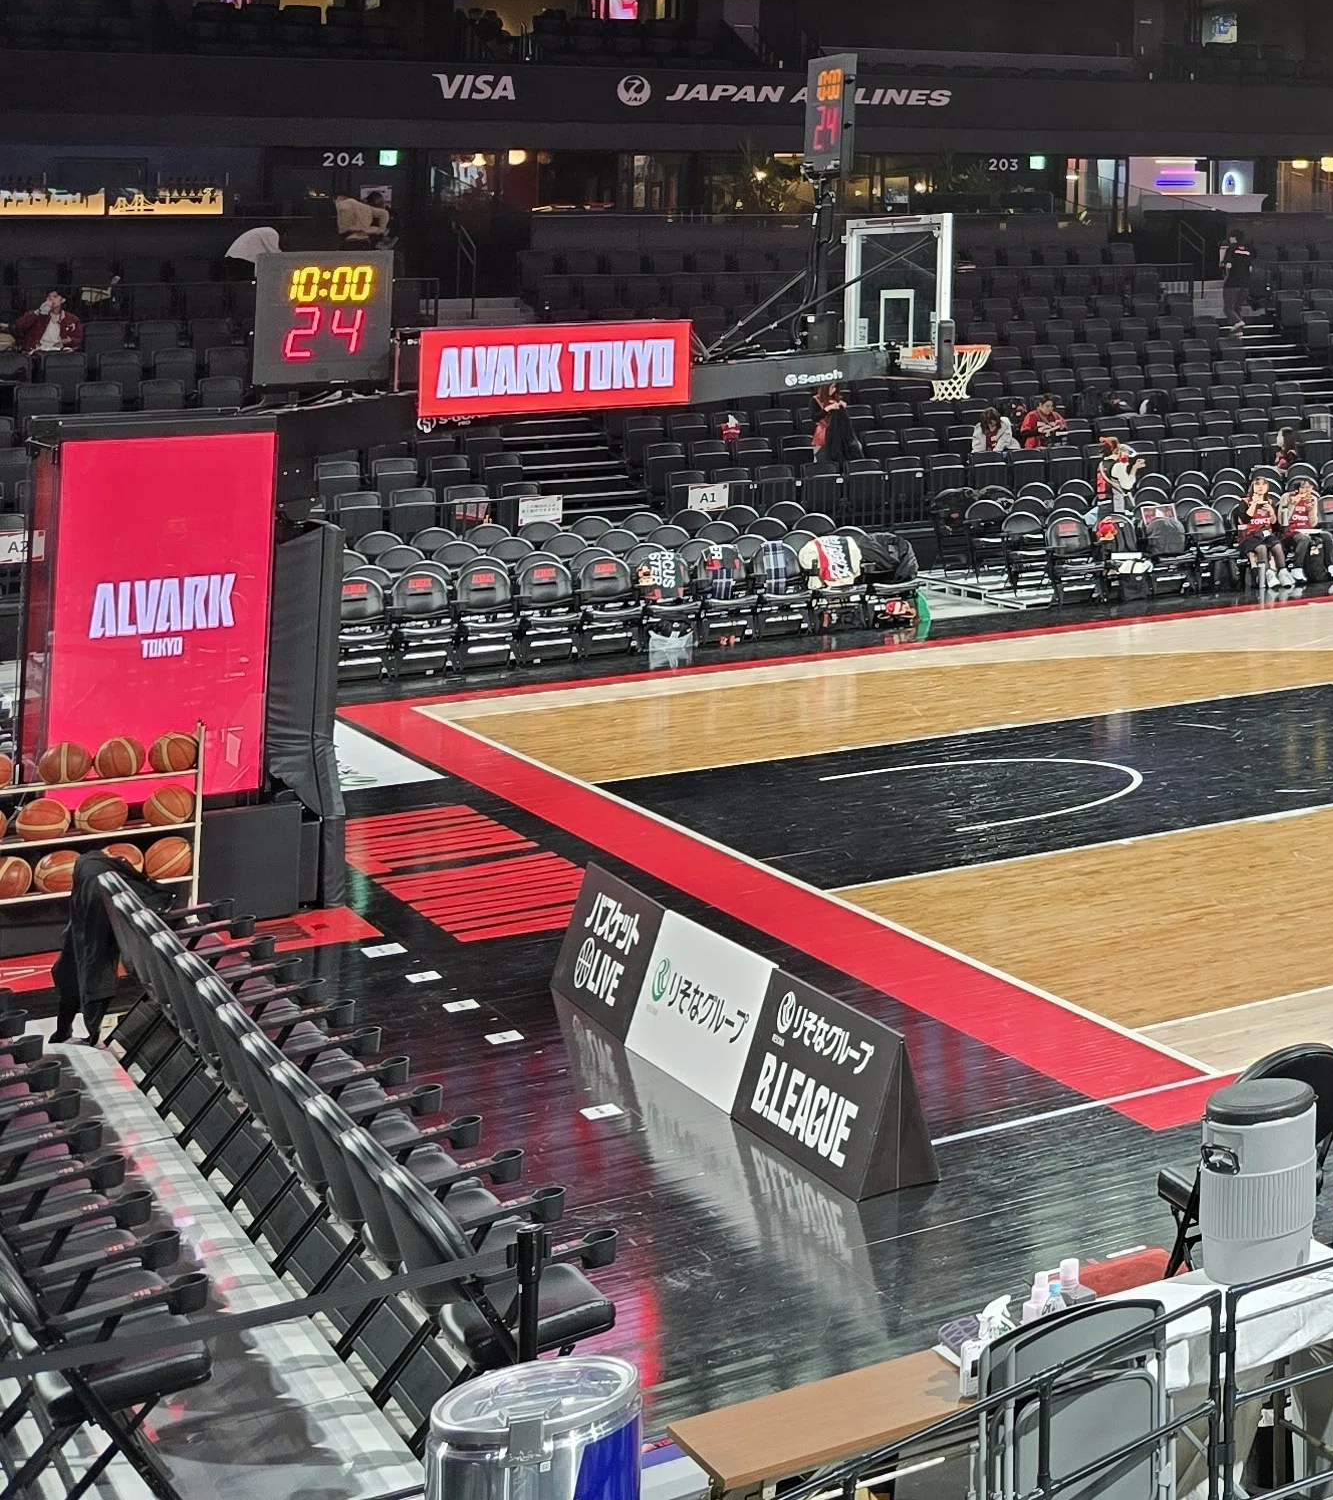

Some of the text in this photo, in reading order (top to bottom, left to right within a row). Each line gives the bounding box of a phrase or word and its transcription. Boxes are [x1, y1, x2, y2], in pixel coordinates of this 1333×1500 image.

[432, 72, 516, 101] VISA
[665, 84, 952, 107] JAPAN ALINES
[322, 152, 365, 166] 204
[988, 158, 1019, 172] 203
[288, 266, 373, 301] 10:00
[284, 307, 364, 361] 24
[436, 338, 675, 398] ALVARK TOKYO
[797, 367, 843, 385] Senoh
[700, 492, 717, 503] A1
[88, 572, 237, 639] ALVARK
[141, 636, 183, 660] TOKYO
[583, 892, 640, 956] バスケット
[590, 948, 625, 1007] LIVE
[668, 972, 750, 1045] りそなグループ
[793, 1005, 875, 1075] りそなグループ
[751, 1052, 859, 1168] B.LEAGUE
